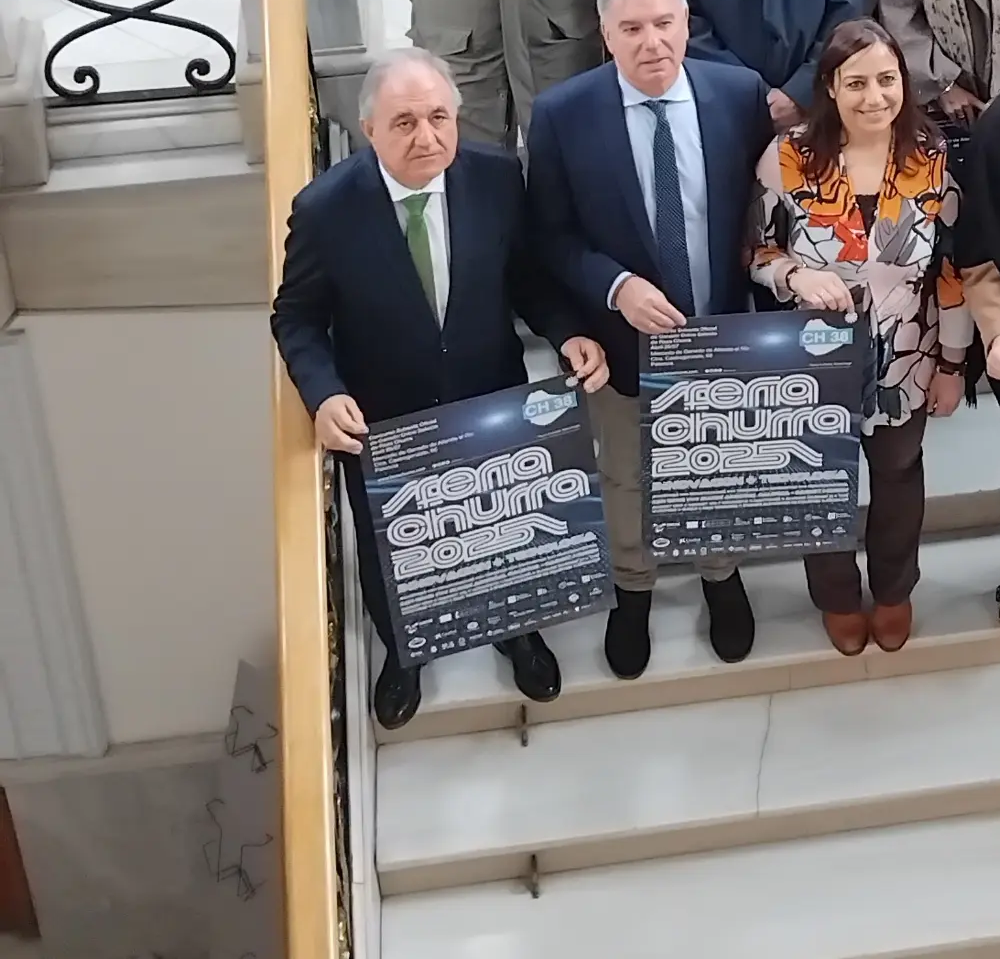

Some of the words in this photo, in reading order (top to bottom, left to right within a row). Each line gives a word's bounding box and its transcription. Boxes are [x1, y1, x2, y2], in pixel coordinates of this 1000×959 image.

[802, 332, 826, 344] CH
[524, 401, 549, 417] CH
[651, 439, 823, 478] 2025
[391, 512, 569, 580] 2025
